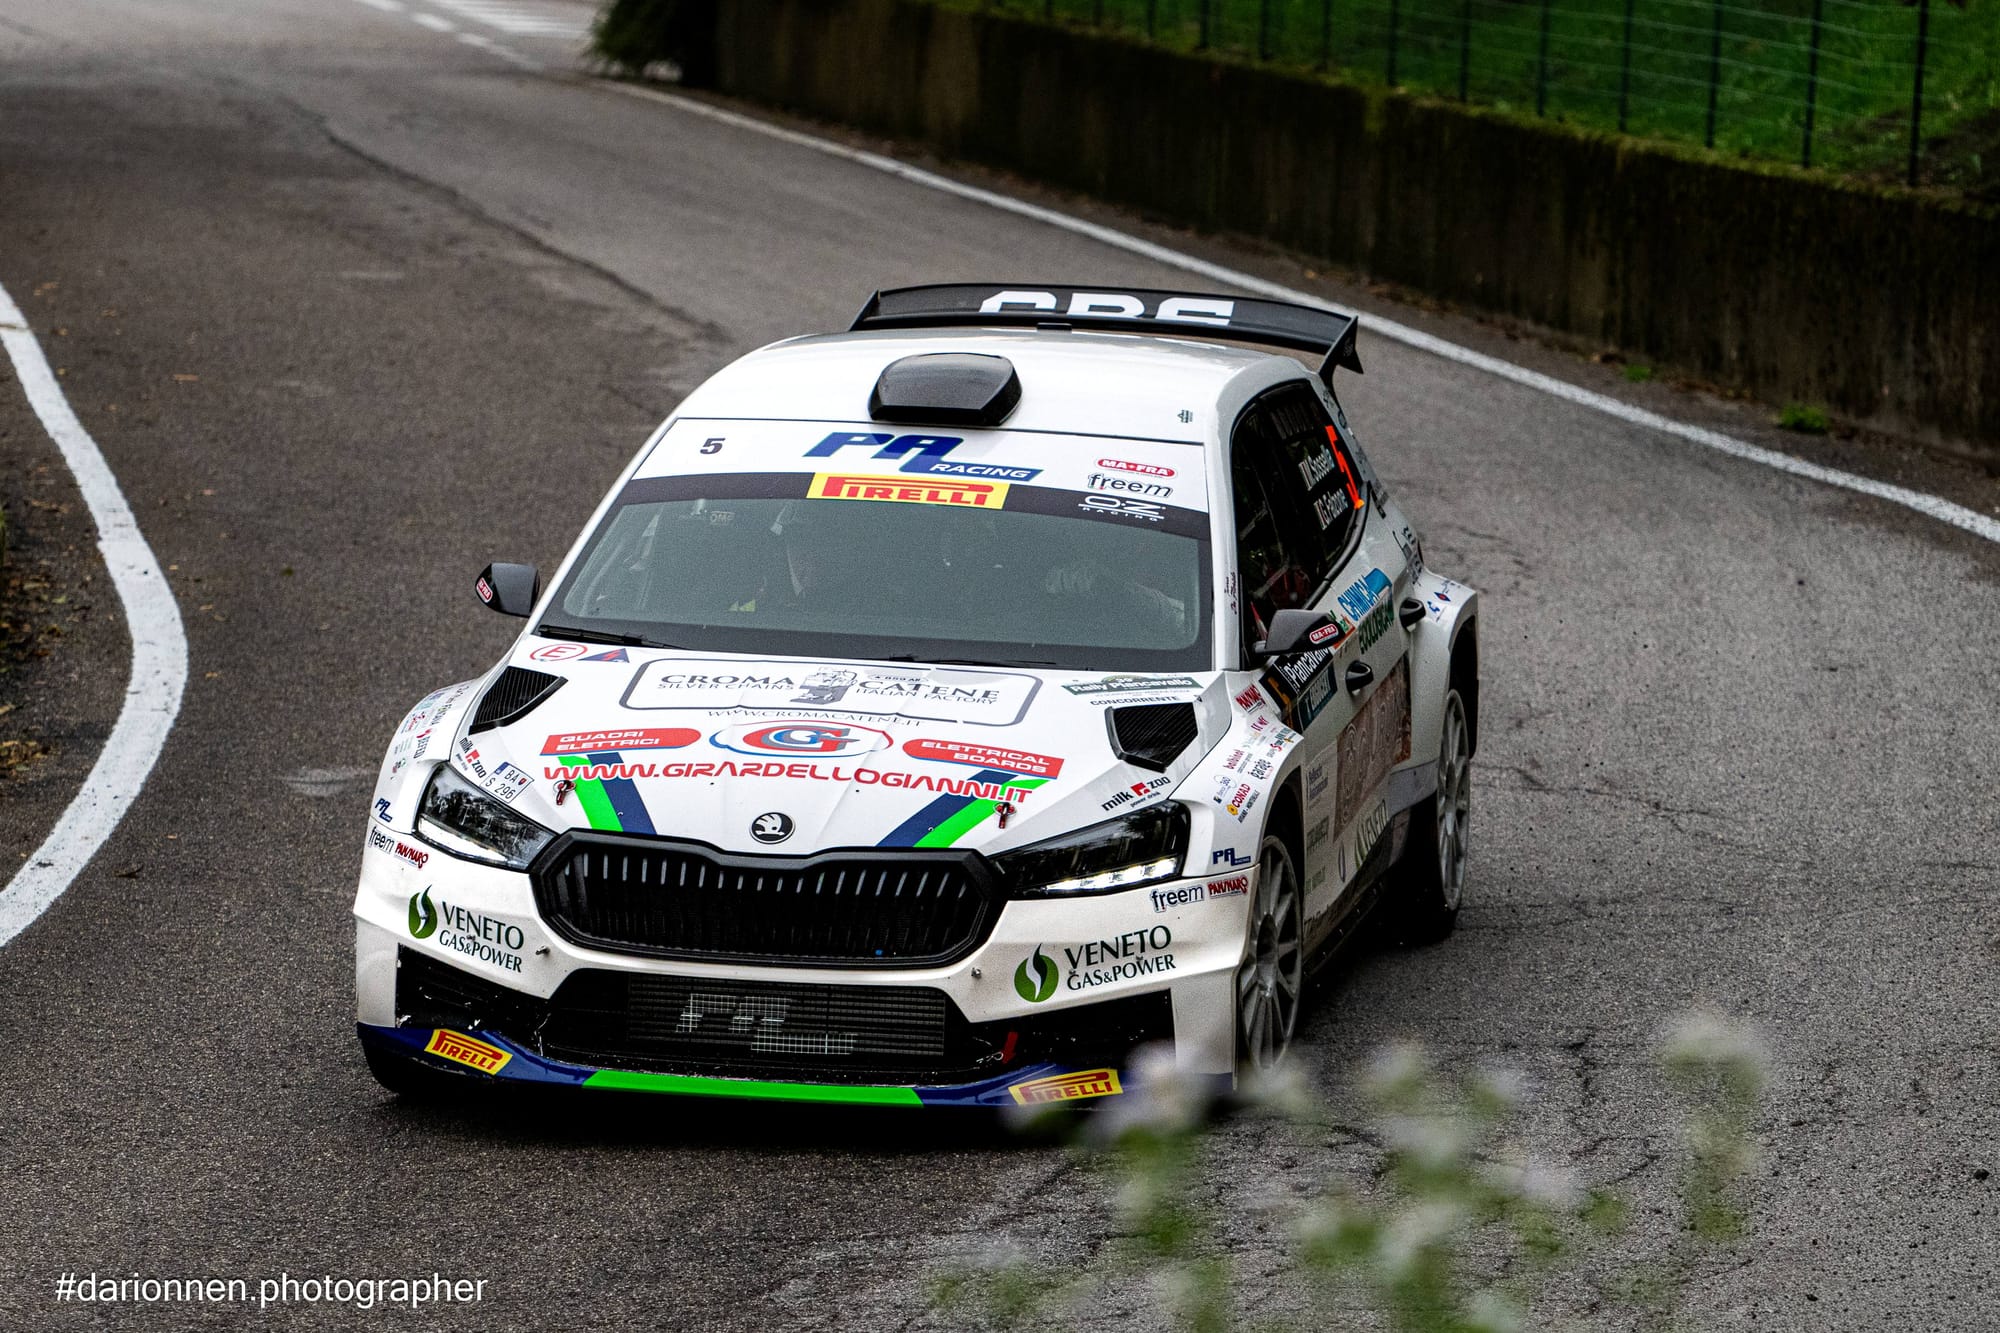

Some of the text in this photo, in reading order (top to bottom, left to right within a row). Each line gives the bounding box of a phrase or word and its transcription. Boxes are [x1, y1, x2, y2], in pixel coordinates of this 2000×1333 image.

[700, 438, 726, 454] 5
[930, 463, 1030, 478] RACING
[822, 476, 994, 506] PIRELLI
[1089, 474, 1174, 497] freem
[661, 675, 795, 685] CROMA
[725, 683, 794, 691] CHAINS
[859, 681, 1000, 698] CATENE
[856, 688, 997, 705] ITALIAN FACTORY
[1090, 696, 1179, 705] CONCORRENTE
[555, 739, 660, 751] ELETTRICI
[559, 731, 643, 742] QUADRI
[459, 737, 474, 753] milk
[472, 760, 487, 778] zoo
[921, 741, 1050, 766] ELETTRICAL
[953, 752, 1048, 773] BOARDS
[485, 777, 516, 800] S 296
[504, 769, 519, 783] BA
[544, 762, 1032, 803] WWW.GIRARDELLOGIANNI.IT
[1101, 776, 1171, 811] milk zoo
[1231, 783, 1251, 808] CONAD
[369, 826, 394, 853] freem
[1151, 886, 1204, 911] freem
[442, 901, 525, 950] VENETO
[439, 929, 522, 973] GAS&POWER
[1063, 925, 1172, 970] VENETO
[1066, 954, 1177, 991] GAS&POWER
[432, 1030, 503, 1070] PIRELLI
[1018, 1071, 1110, 1103] PIRELLI
